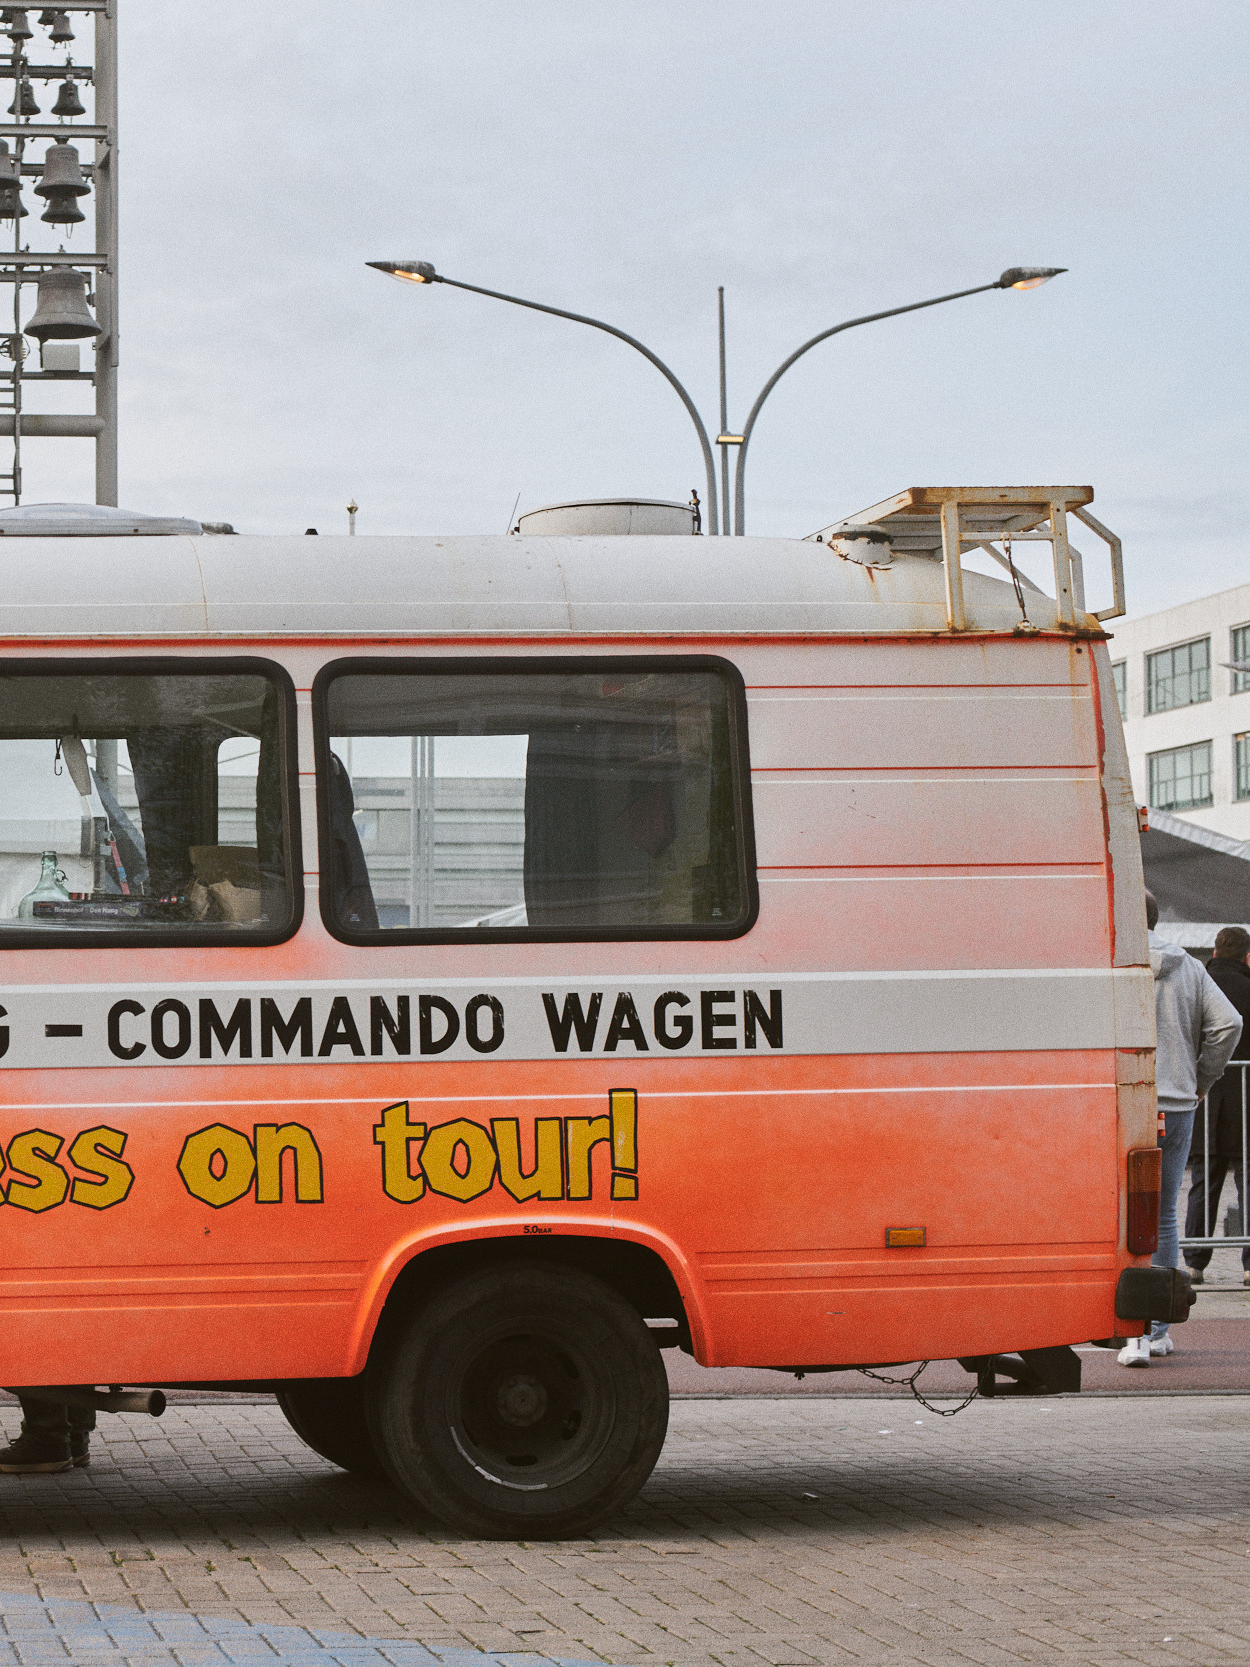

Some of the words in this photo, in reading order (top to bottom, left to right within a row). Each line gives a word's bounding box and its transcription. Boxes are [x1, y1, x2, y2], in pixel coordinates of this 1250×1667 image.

[54, 905, 84, 913] Binnenhof
[102, 906, 119, 915] Haag
[107, 993, 505, 1060] COMMANDO
[541, 989, 784, 1052] WAGEN
[176, 1122, 325, 1209] on
[373, 1087, 640, 1205] tour!
